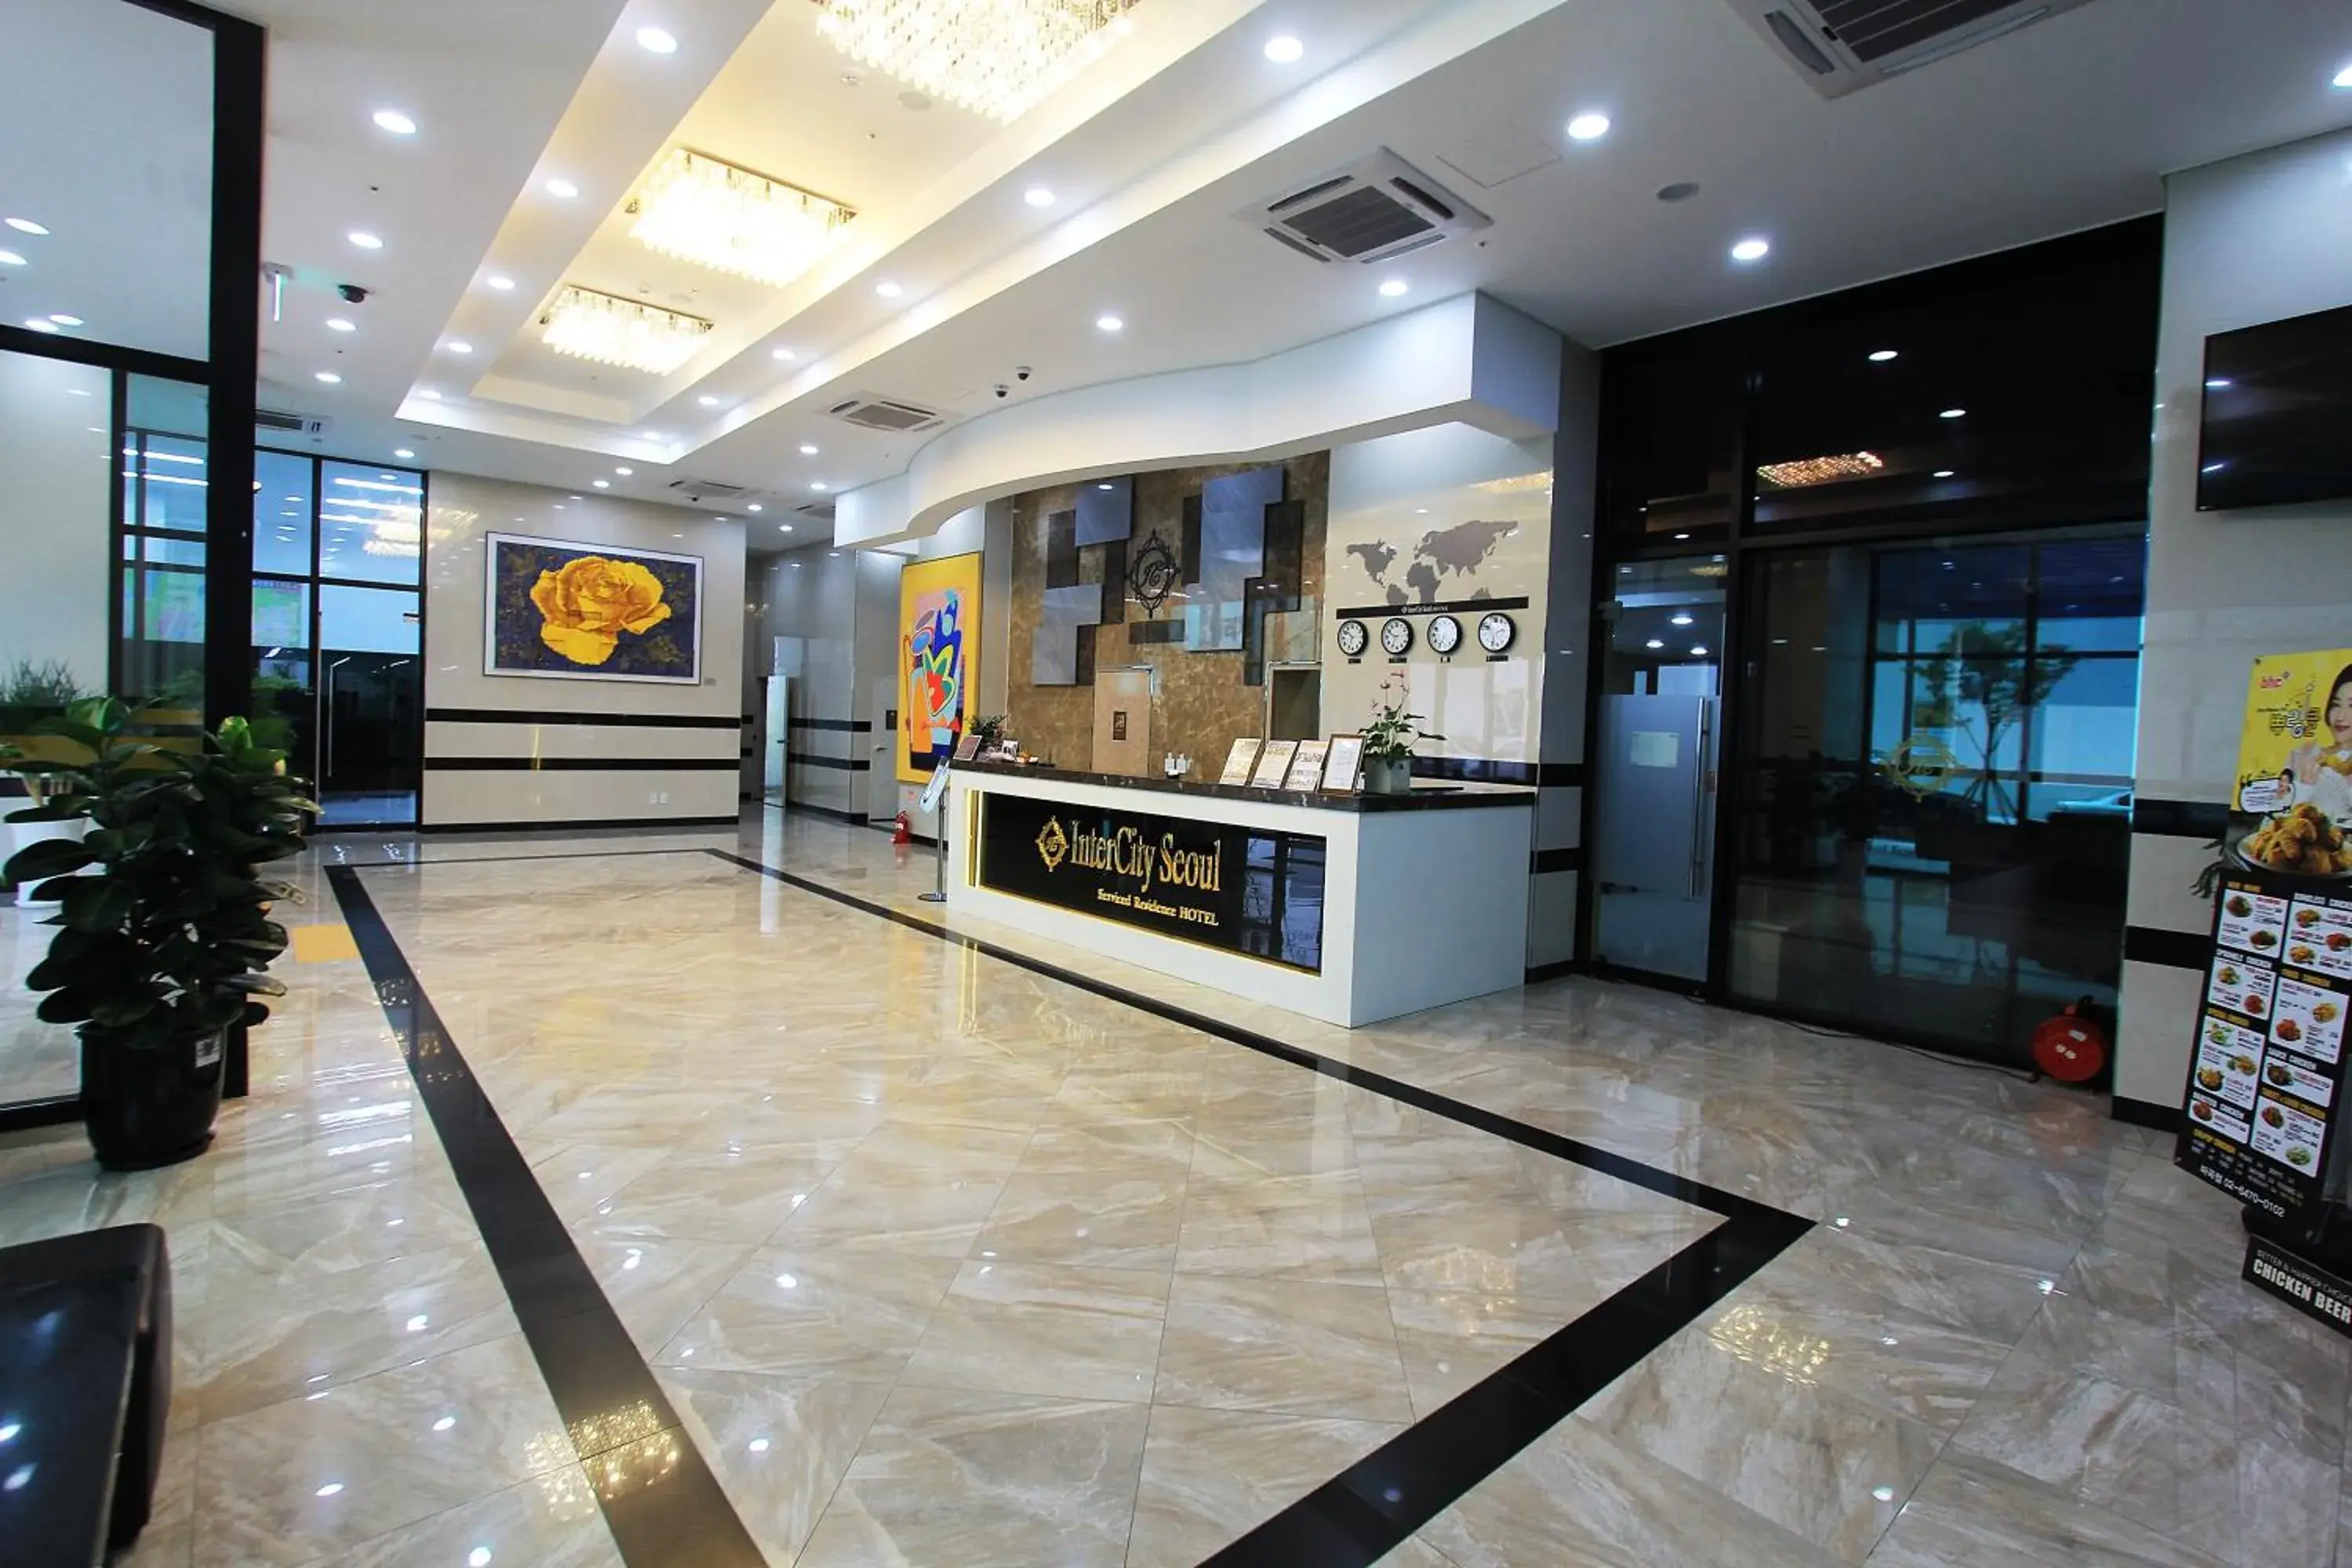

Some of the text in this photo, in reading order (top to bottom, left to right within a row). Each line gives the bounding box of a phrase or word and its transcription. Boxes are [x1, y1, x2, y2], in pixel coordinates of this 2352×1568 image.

[1070, 819, 1221, 892] InterCity Seoul
[1178, 905, 1219, 927] HOTEL
[2252, 1258, 2352, 1324] CHICKEN BEER
